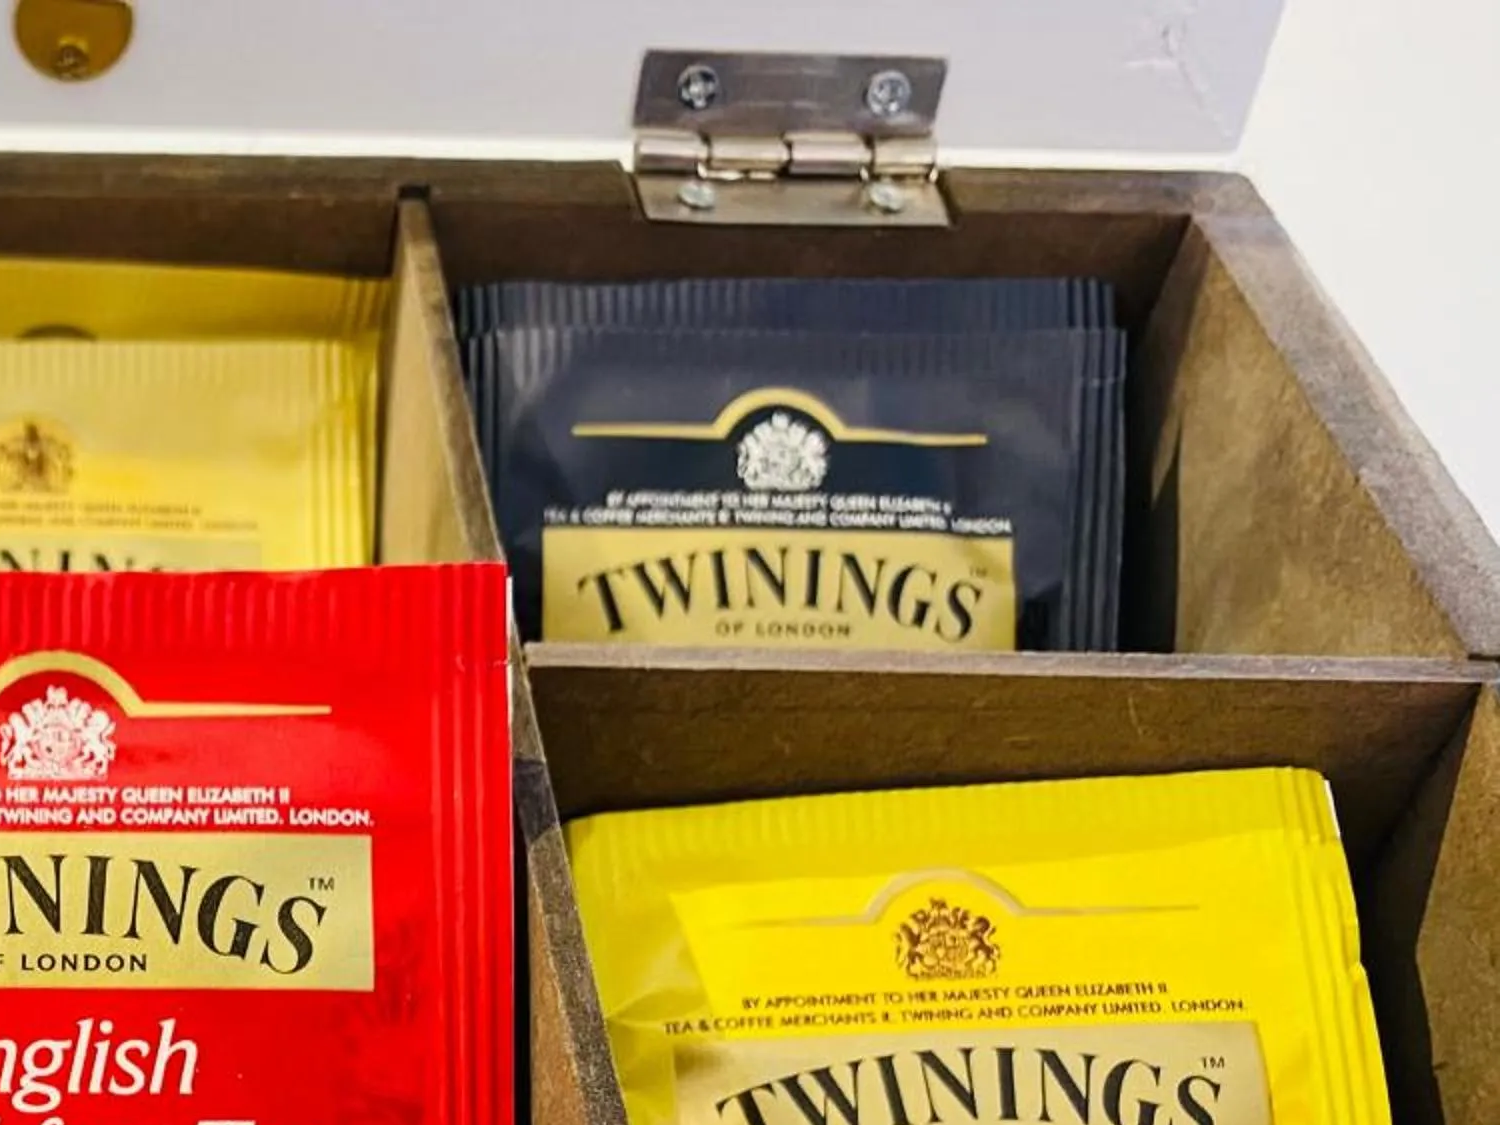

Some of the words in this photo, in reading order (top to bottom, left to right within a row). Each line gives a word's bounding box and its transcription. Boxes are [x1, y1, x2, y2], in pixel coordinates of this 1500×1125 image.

[577, 545, 983, 642] TWININGS
[715, 619, 742, 636] OF
[755, 620, 852, 639] LONDON
[6, 787, 40, 803] HER
[43, 787, 117, 804] MAJESTY
[120, 787, 184, 804] QUEEN
[187, 787, 275, 804] ELIZABETH
[76, 808, 116, 825] AND
[120, 808, 209, 825] COMPANY
[21, 952, 148, 973] LONDON
[764, 993, 877, 1009] APPOINTMENT
[907, 990, 938, 1003] HER
[942, 987, 1010, 1002] MAJESTY
[1015, 984, 1071, 998] QUEEN
[1075, 981, 1153, 997] ELIZABETH
[664, 1020, 693, 1035] TEA
[713, 1016, 772, 1031] COFFEE
[781, 1011, 876, 1027] MERCHANTS
[900, 1007, 973, 1022] TWINING
[978, 1006, 1013, 1019] AND
[1016, 1002, 1098, 1018] COMPANY
